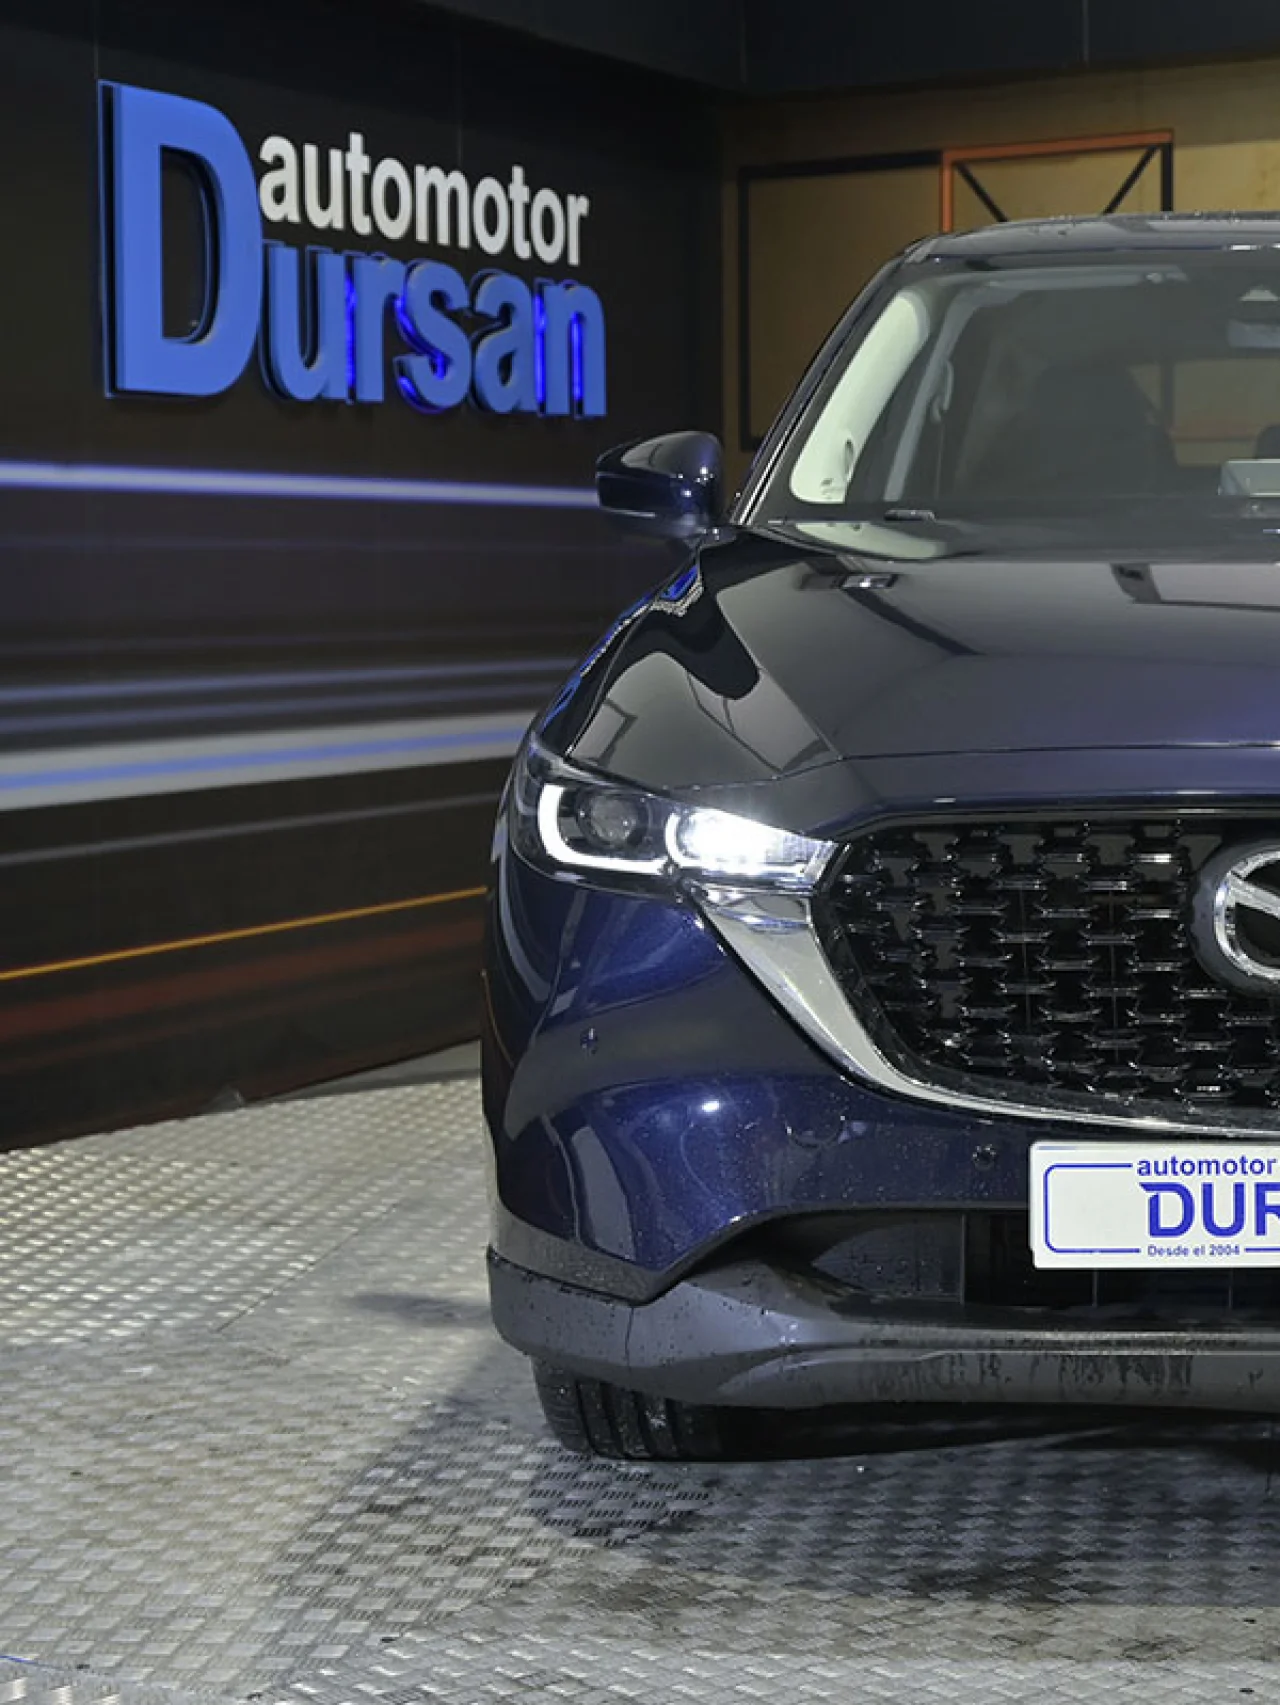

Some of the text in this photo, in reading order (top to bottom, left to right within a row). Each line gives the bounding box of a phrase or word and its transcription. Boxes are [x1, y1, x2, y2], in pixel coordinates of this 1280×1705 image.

[258, 131, 588, 266] automotor
[98, 79, 607, 417] Dursan
[1136, 1155, 1277, 1177] automotor
[1147, 1243, 1240, 1257] Desde el 2004
